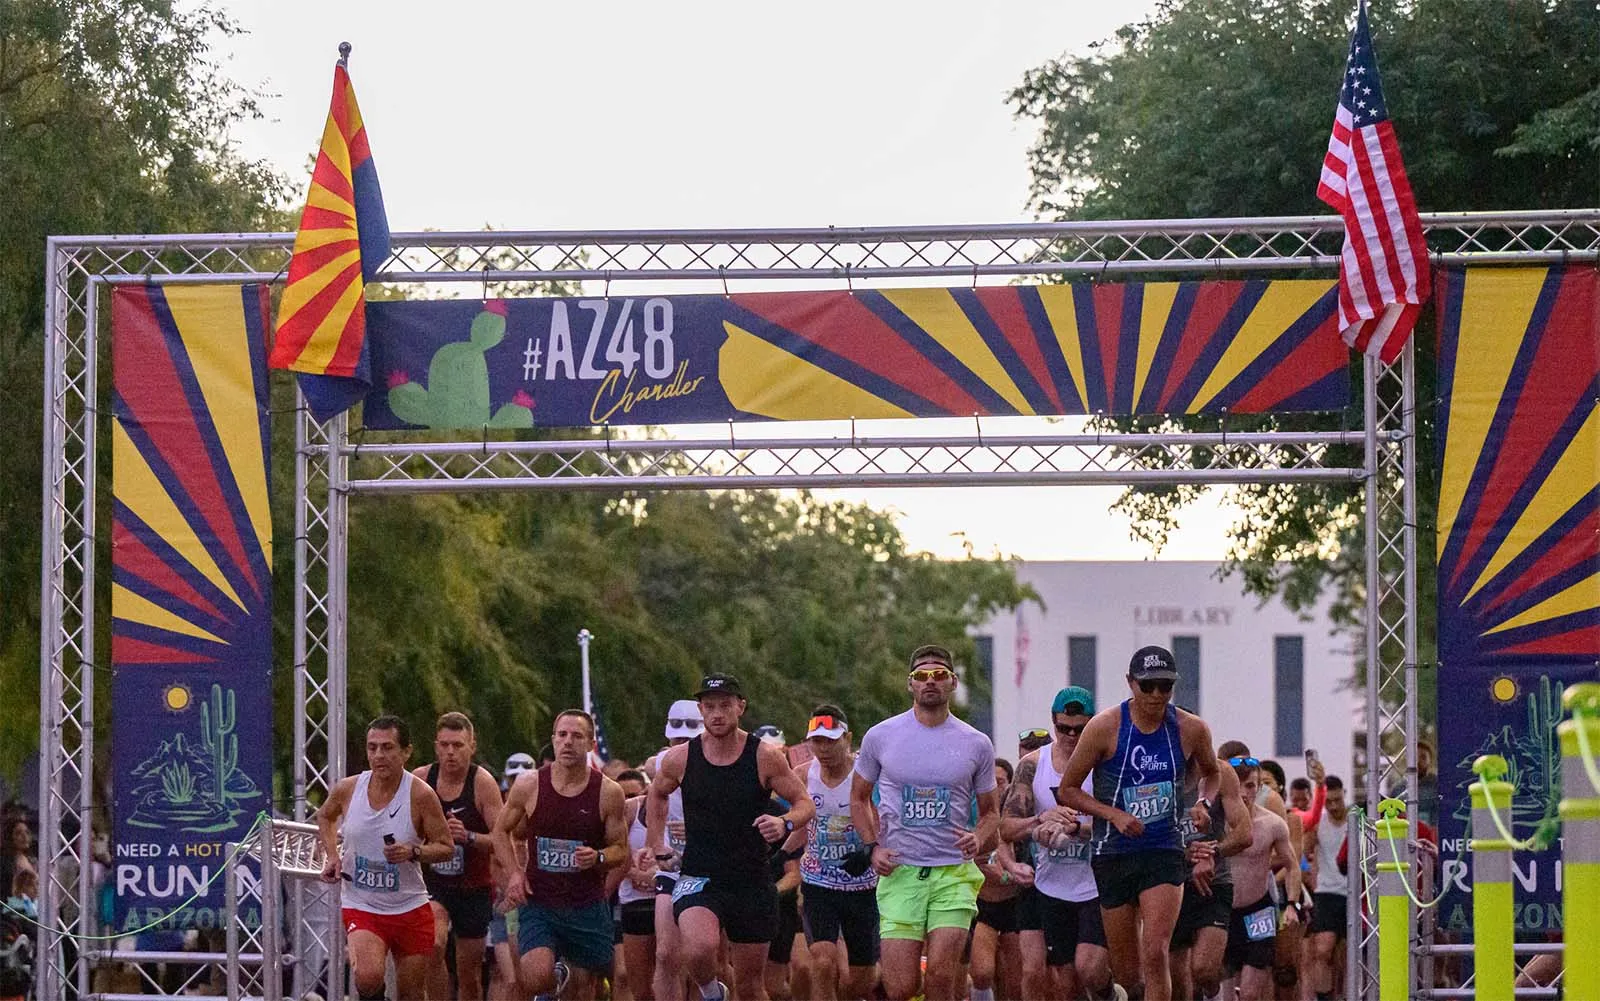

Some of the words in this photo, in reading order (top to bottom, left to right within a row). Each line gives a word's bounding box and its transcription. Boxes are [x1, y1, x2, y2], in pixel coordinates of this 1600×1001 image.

[523, 297, 673, 380] #AZ48
[590, 359, 704, 424] Chandler
[904, 801, 947, 819] 3562
[1129, 796, 1170, 819] 2812
[117, 843, 161, 857] NEED
[167, 843, 180, 857] A
[186, 843, 222, 857] HOT
[1442, 838, 1473, 852] NEE
[117, 864, 209, 897] RUN
[358, 869, 395, 888] 2816
[1442, 860, 1537, 892] RN
